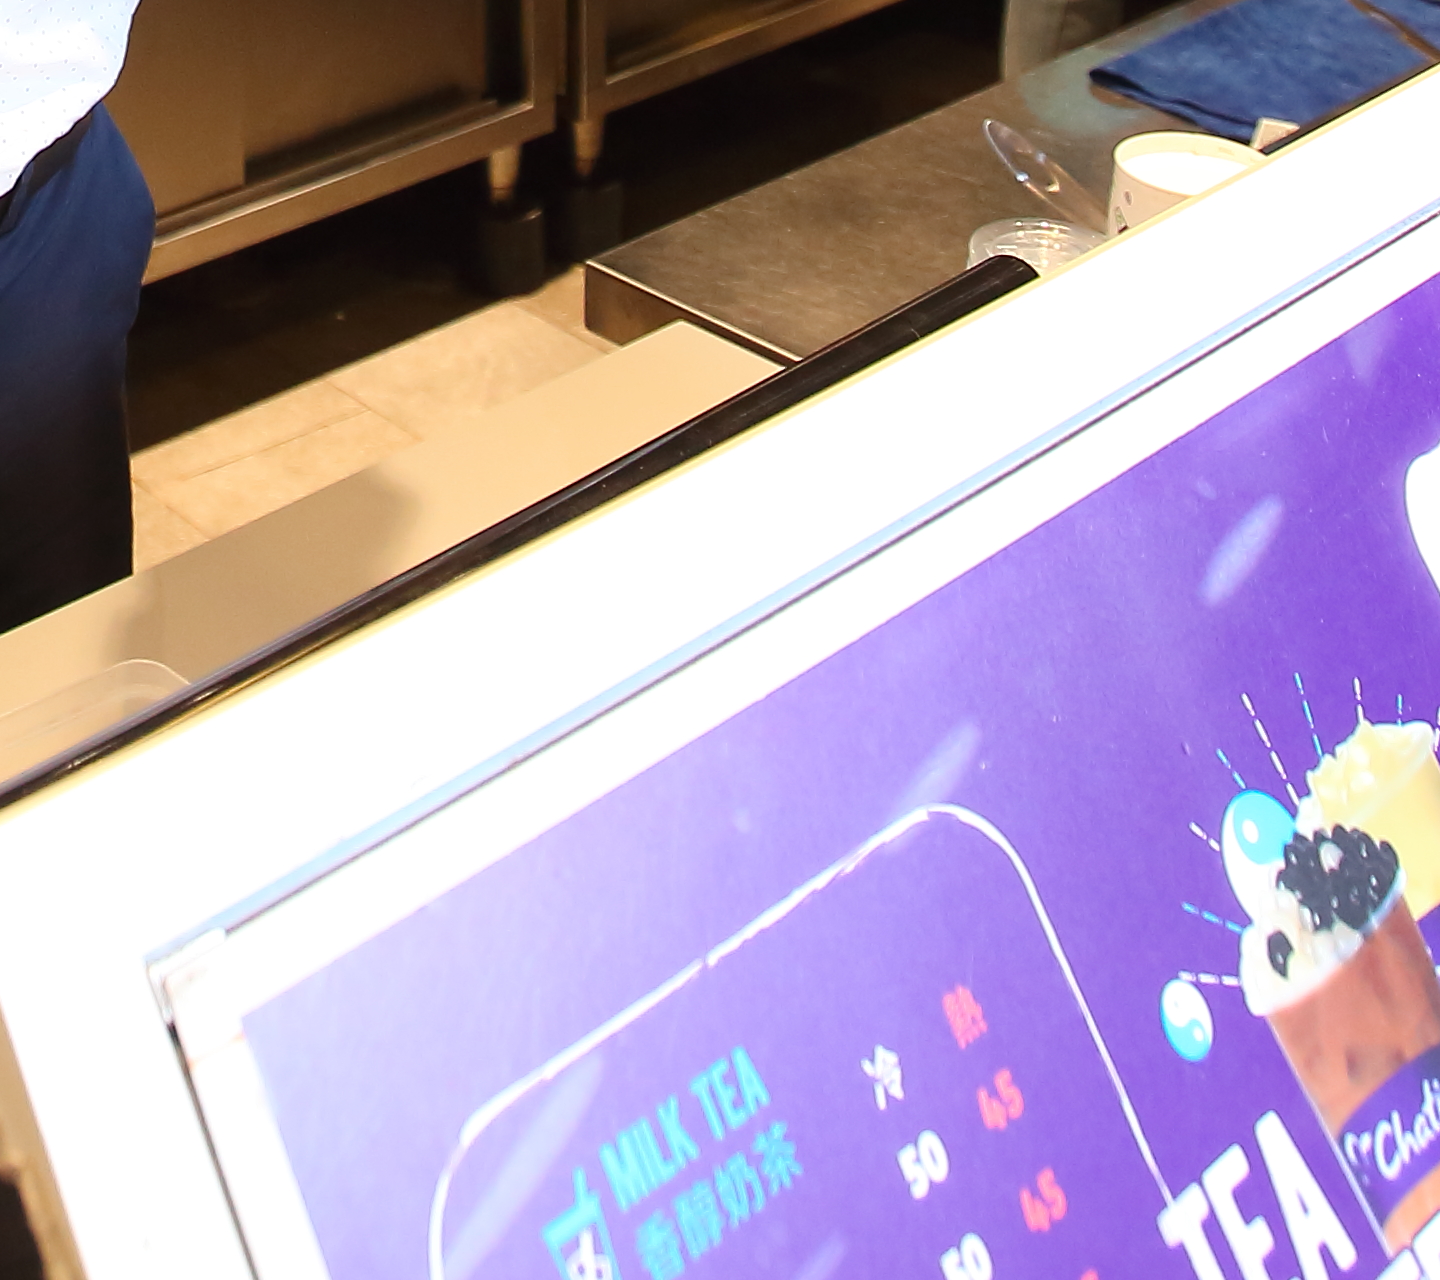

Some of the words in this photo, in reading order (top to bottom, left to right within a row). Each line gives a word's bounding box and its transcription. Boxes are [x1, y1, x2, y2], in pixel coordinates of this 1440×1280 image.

[598, 1093, 701, 1213] MILK
[688, 1044, 772, 1142] TEA
[635, 1118, 805, 1280] 香醇奶茶
[896, 1128, 950, 1201] 50
[976, 1067, 1025, 1132] 45
[1019, 1164, 1068, 1233] 45
